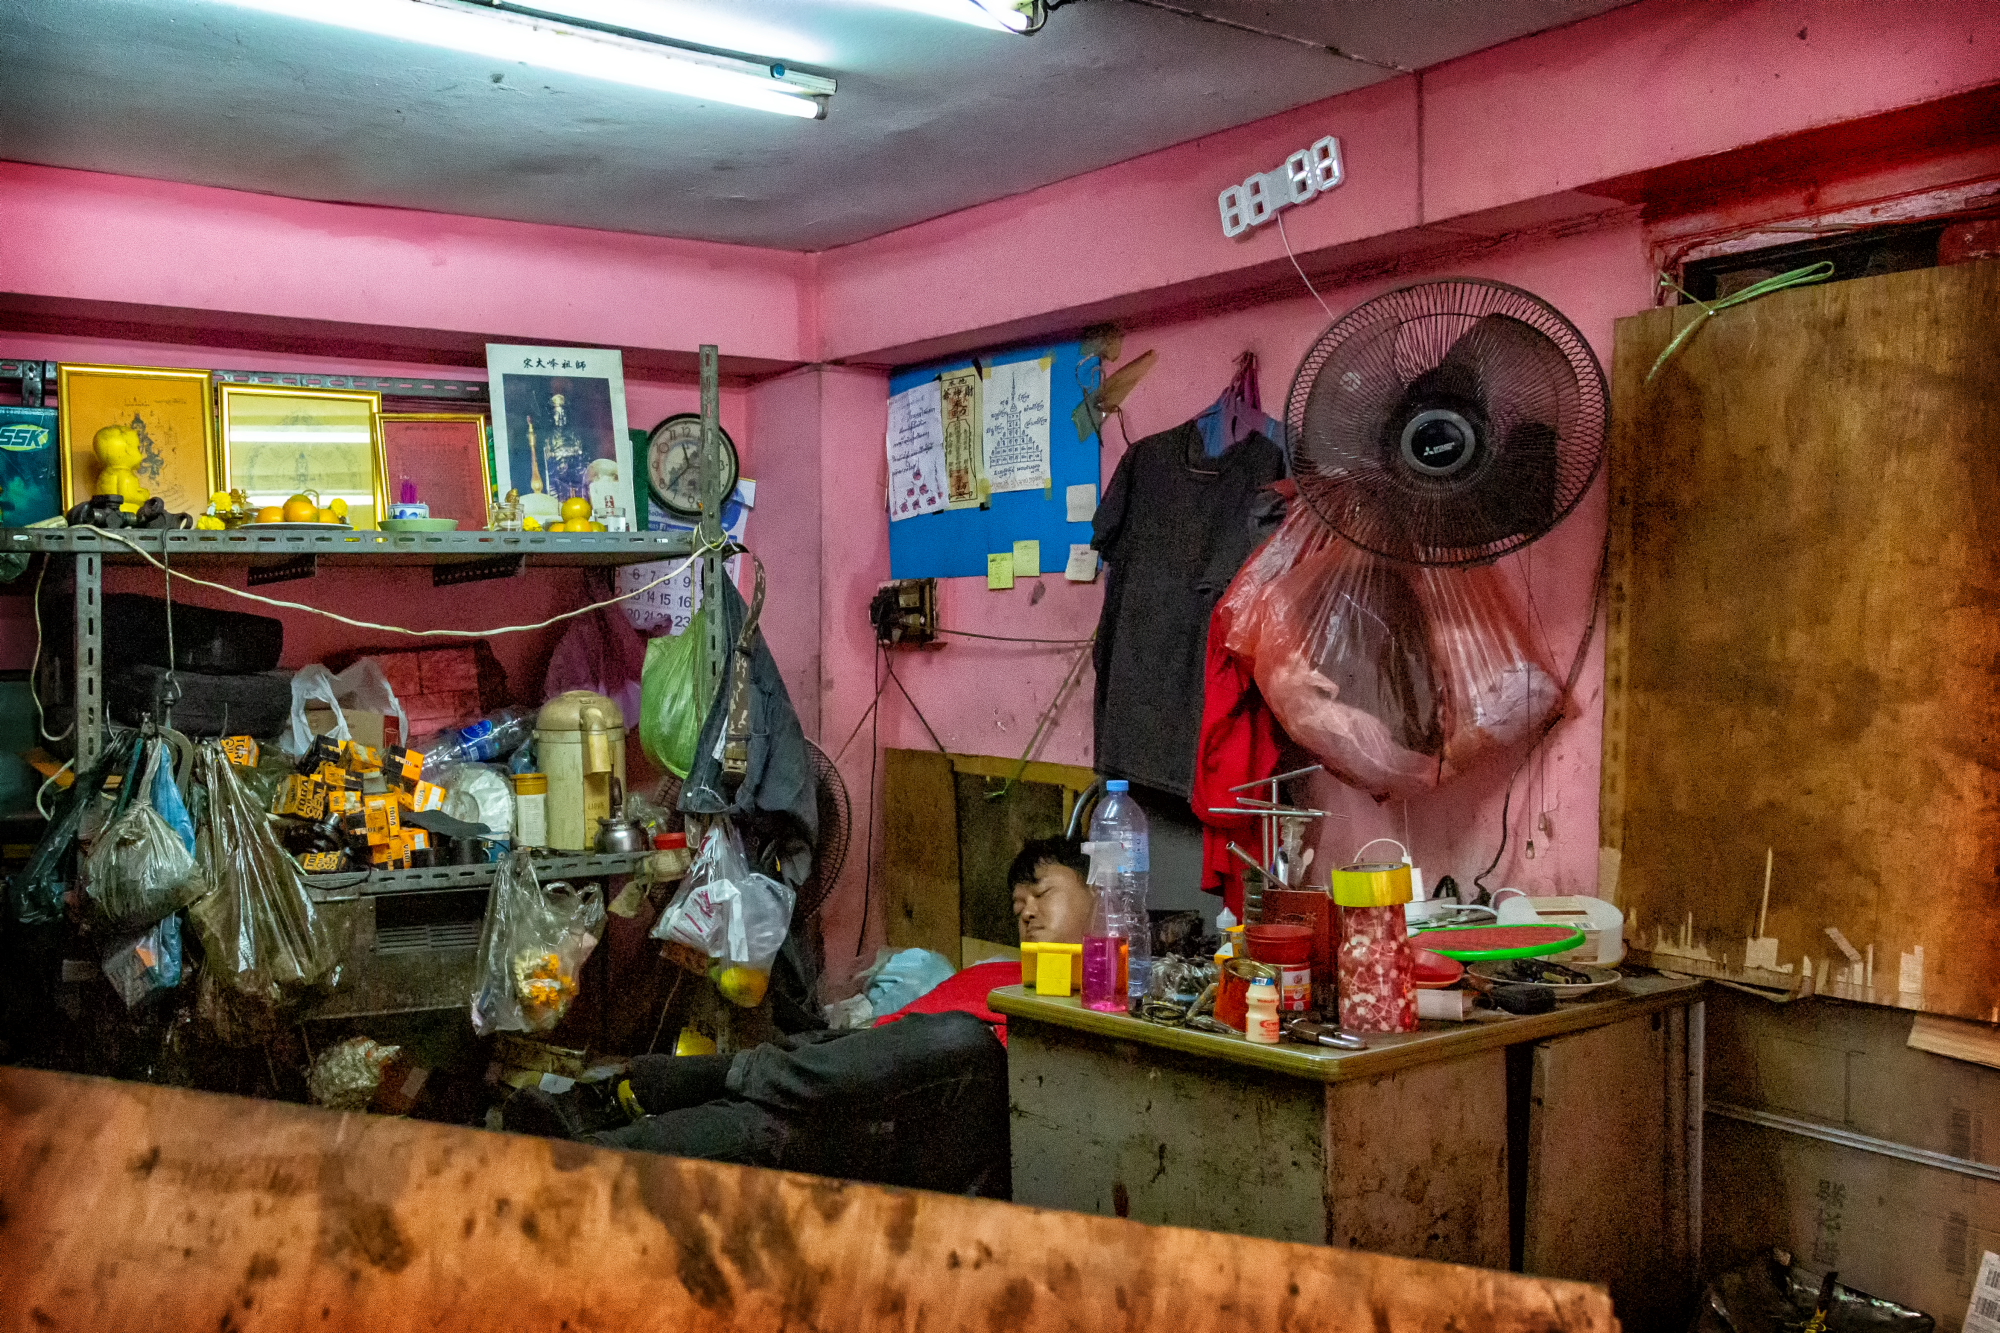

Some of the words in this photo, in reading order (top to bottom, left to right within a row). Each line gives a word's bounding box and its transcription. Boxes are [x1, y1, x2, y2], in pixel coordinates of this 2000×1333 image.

[633, 568, 641, 580] 6
[650, 571, 656, 583] 7
[683, 576, 691, 588] 9
[646, 591, 655, 604] 14
[660, 593, 671, 606] 15
[679, 596, 692, 608] 16
[674, 615, 691, 628] 23
